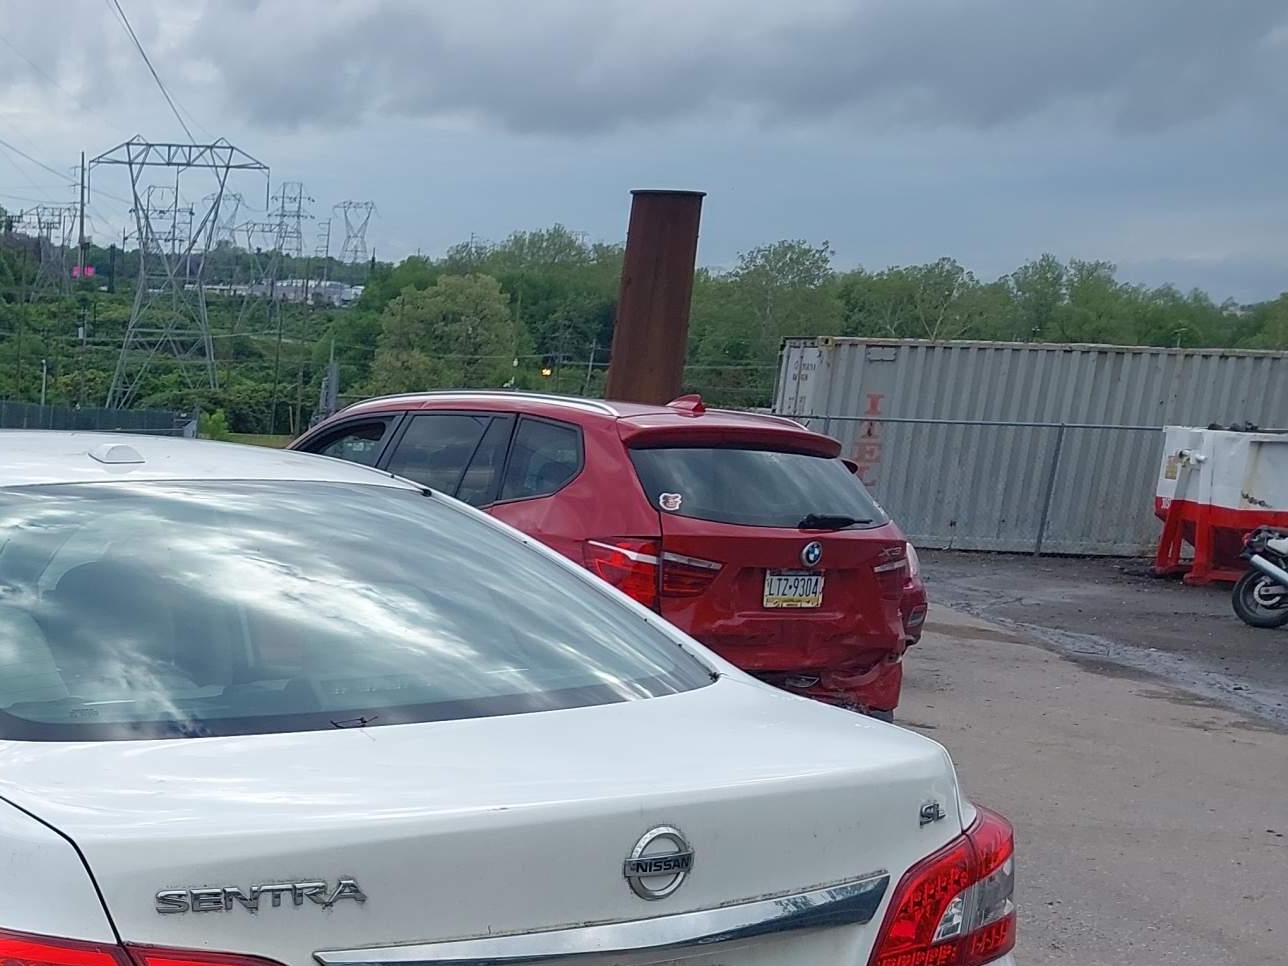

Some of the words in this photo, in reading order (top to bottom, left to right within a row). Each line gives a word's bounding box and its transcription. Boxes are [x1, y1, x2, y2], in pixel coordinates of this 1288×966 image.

[919, 803, 946, 826] SL
[635, 857, 690, 873] NISSAN
[155, 879, 367, 914] SENTRA
